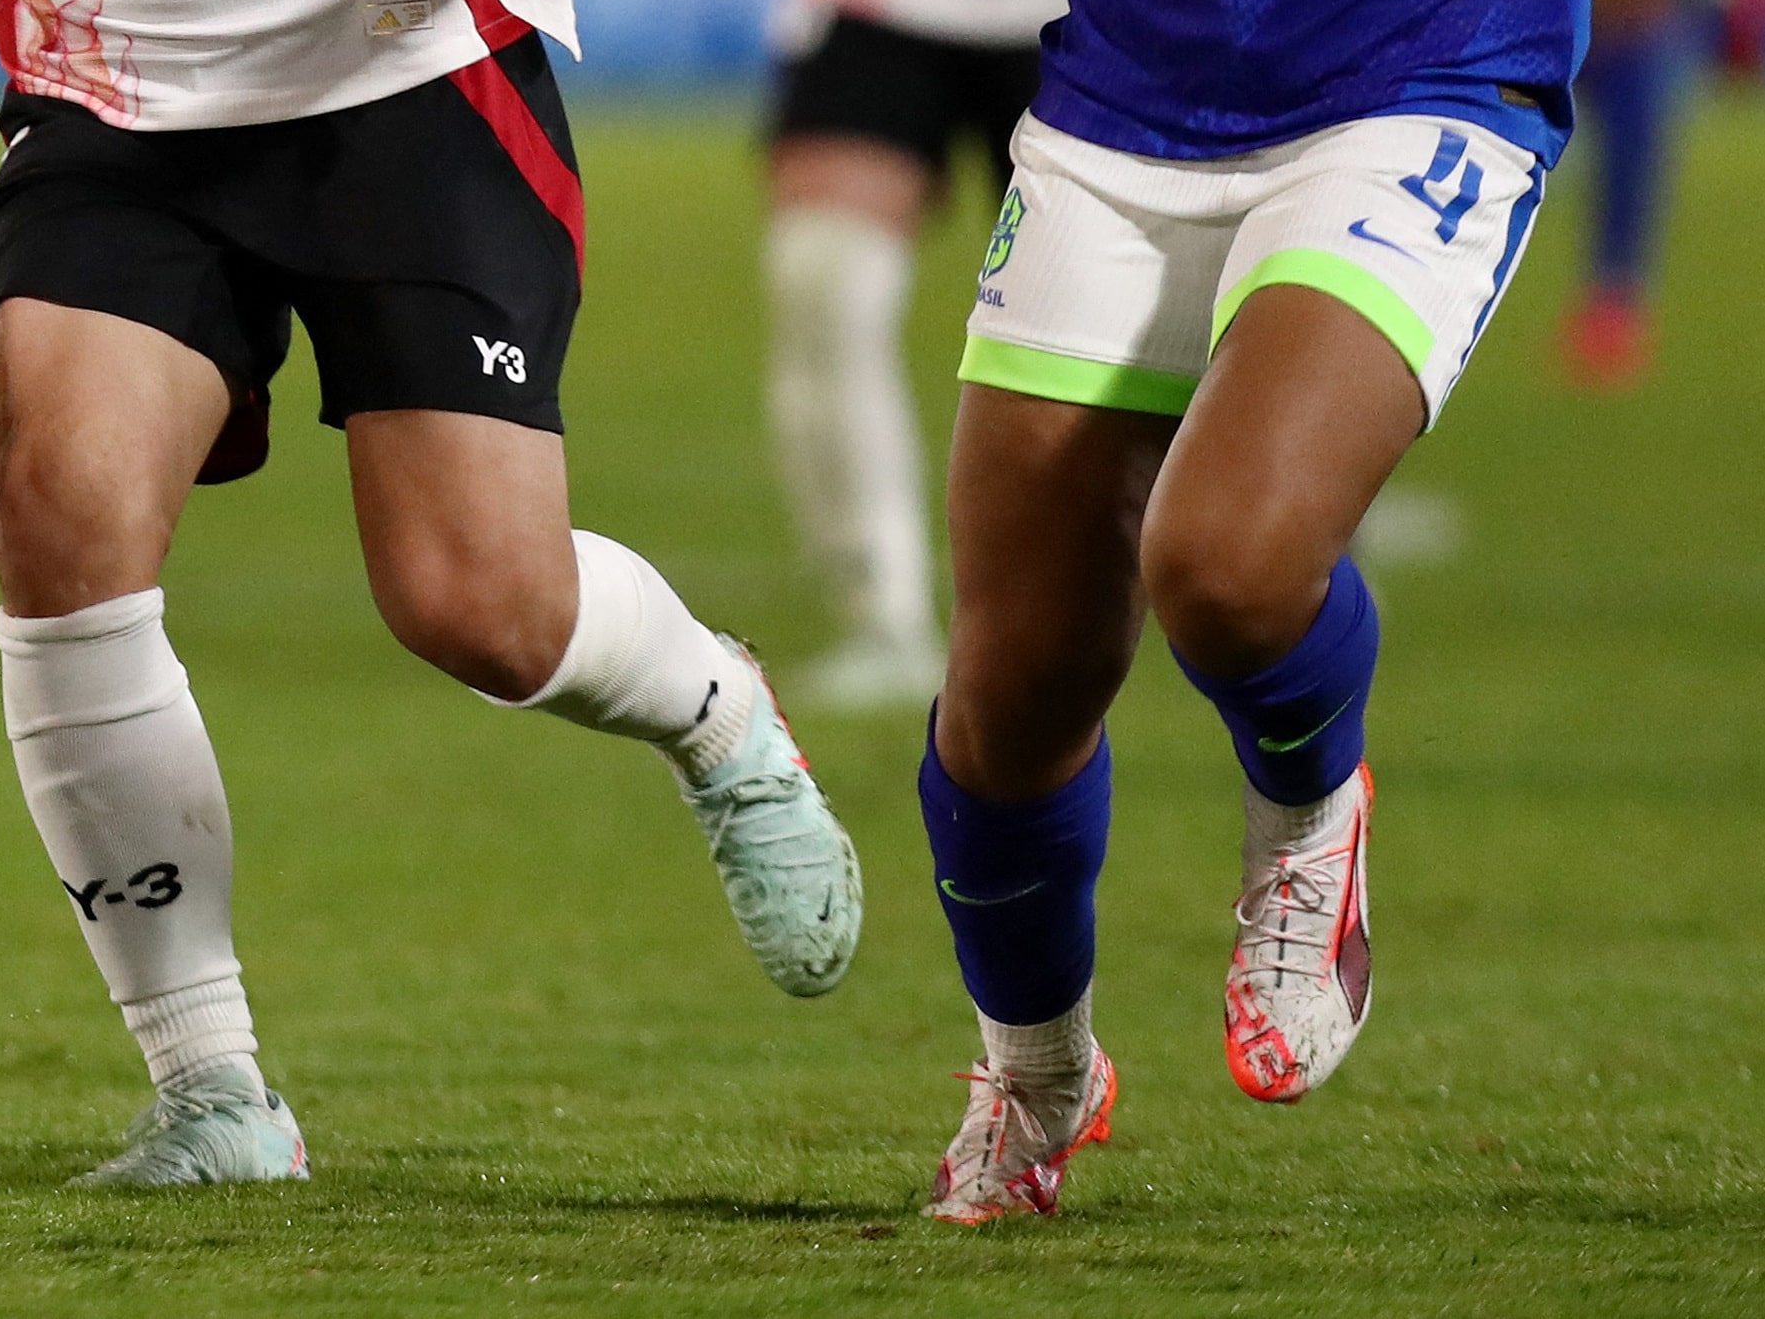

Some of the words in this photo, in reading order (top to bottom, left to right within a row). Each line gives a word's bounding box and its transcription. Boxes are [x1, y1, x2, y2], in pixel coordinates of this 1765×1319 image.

[1398, 129, 1484, 245] 4
[471, 335, 527, 384] Y-3
[62, 862, 183, 921] Y-3
